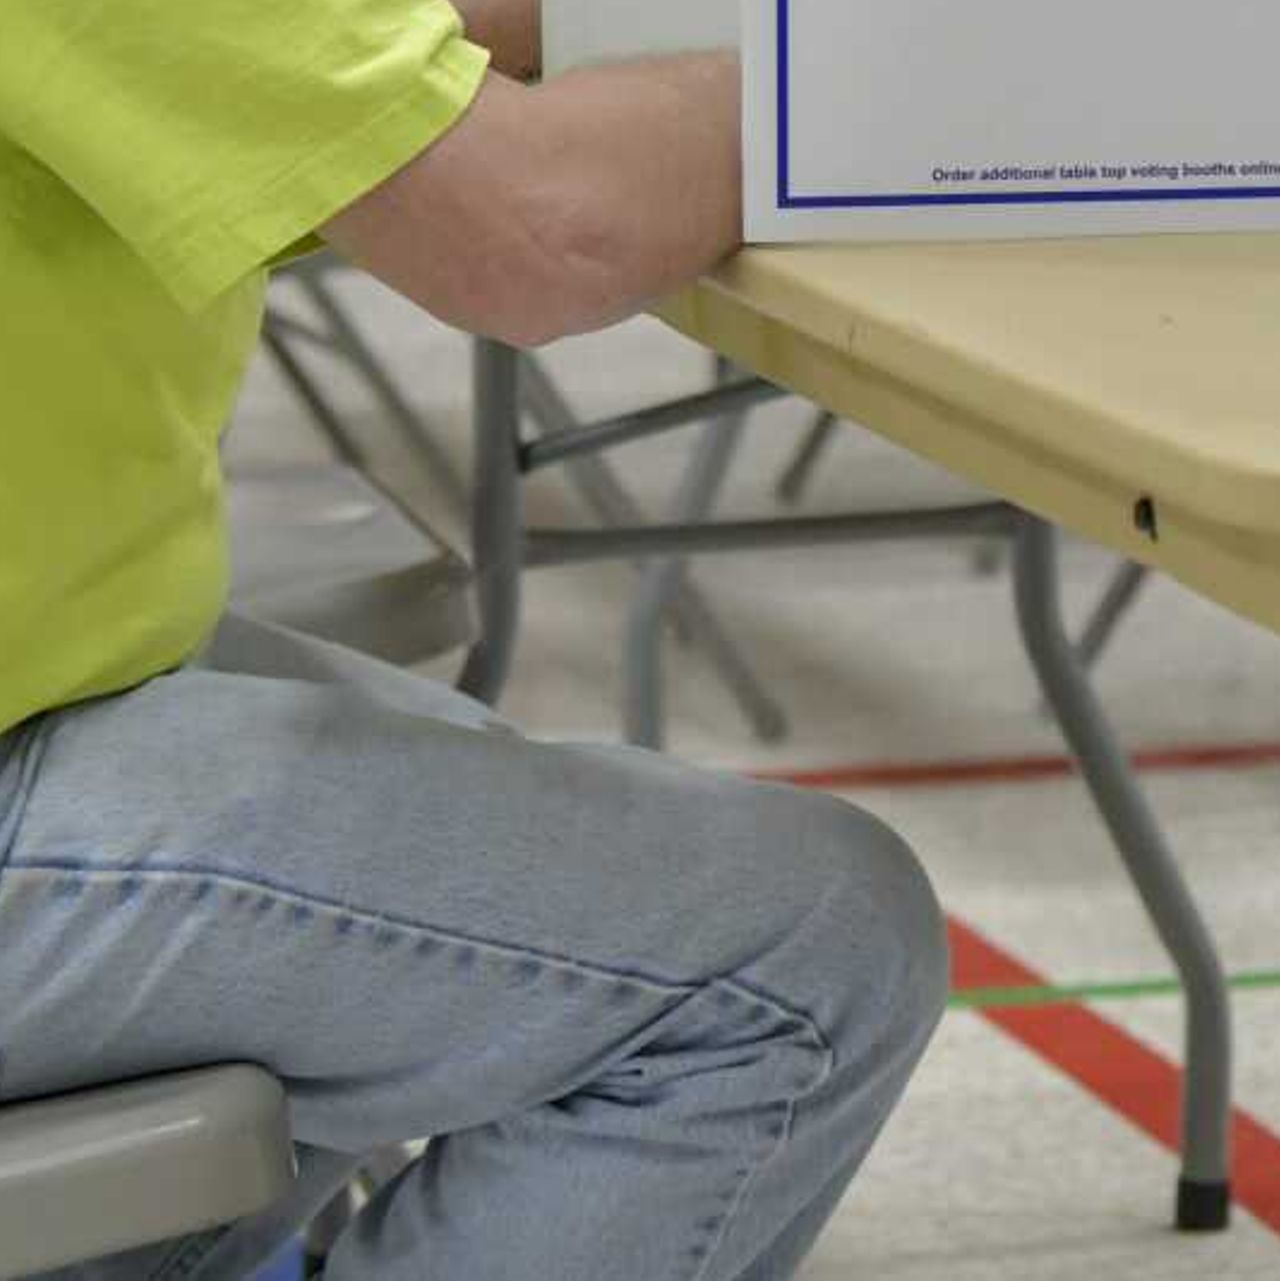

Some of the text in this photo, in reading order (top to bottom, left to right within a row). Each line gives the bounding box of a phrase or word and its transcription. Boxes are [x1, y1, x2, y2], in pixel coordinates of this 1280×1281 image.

[932, 167, 975, 181] Order
[980, 166, 1056, 180] additional
[1059, 165, 1096, 179] table
[1101, 164, 1125, 181] top
[1131, 162, 1178, 180] voting
[1182, 162, 1235, 177] booths
